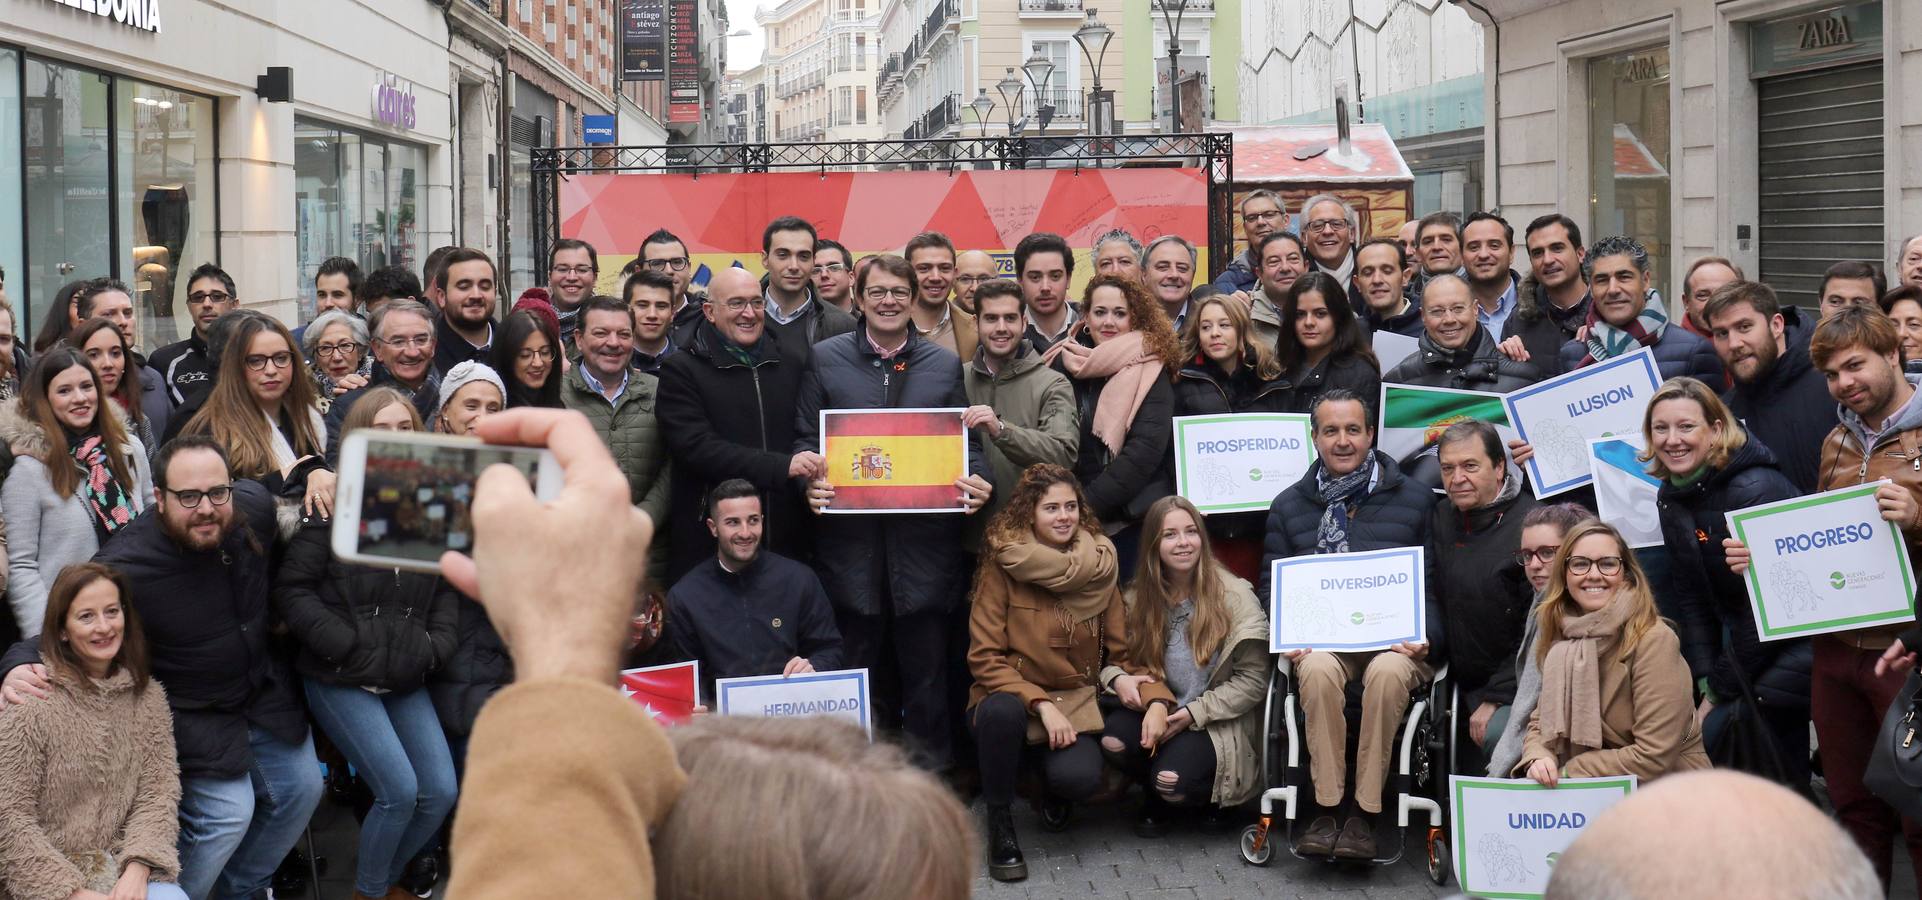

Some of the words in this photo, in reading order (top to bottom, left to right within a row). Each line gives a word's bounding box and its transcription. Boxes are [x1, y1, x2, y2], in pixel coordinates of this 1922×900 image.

[1798, 16, 1851, 49] ZARA
[1566, 384, 1634, 418] ILUSION
[1197, 438, 1300, 455] PROSPERIDAD
[1774, 522, 1873, 556] PROGRESO
[1320, 572, 1409, 591] DIVERSIDAD
[764, 697, 859, 718] HERMANDAD
[1508, 812, 1586, 830] UNIDAD
